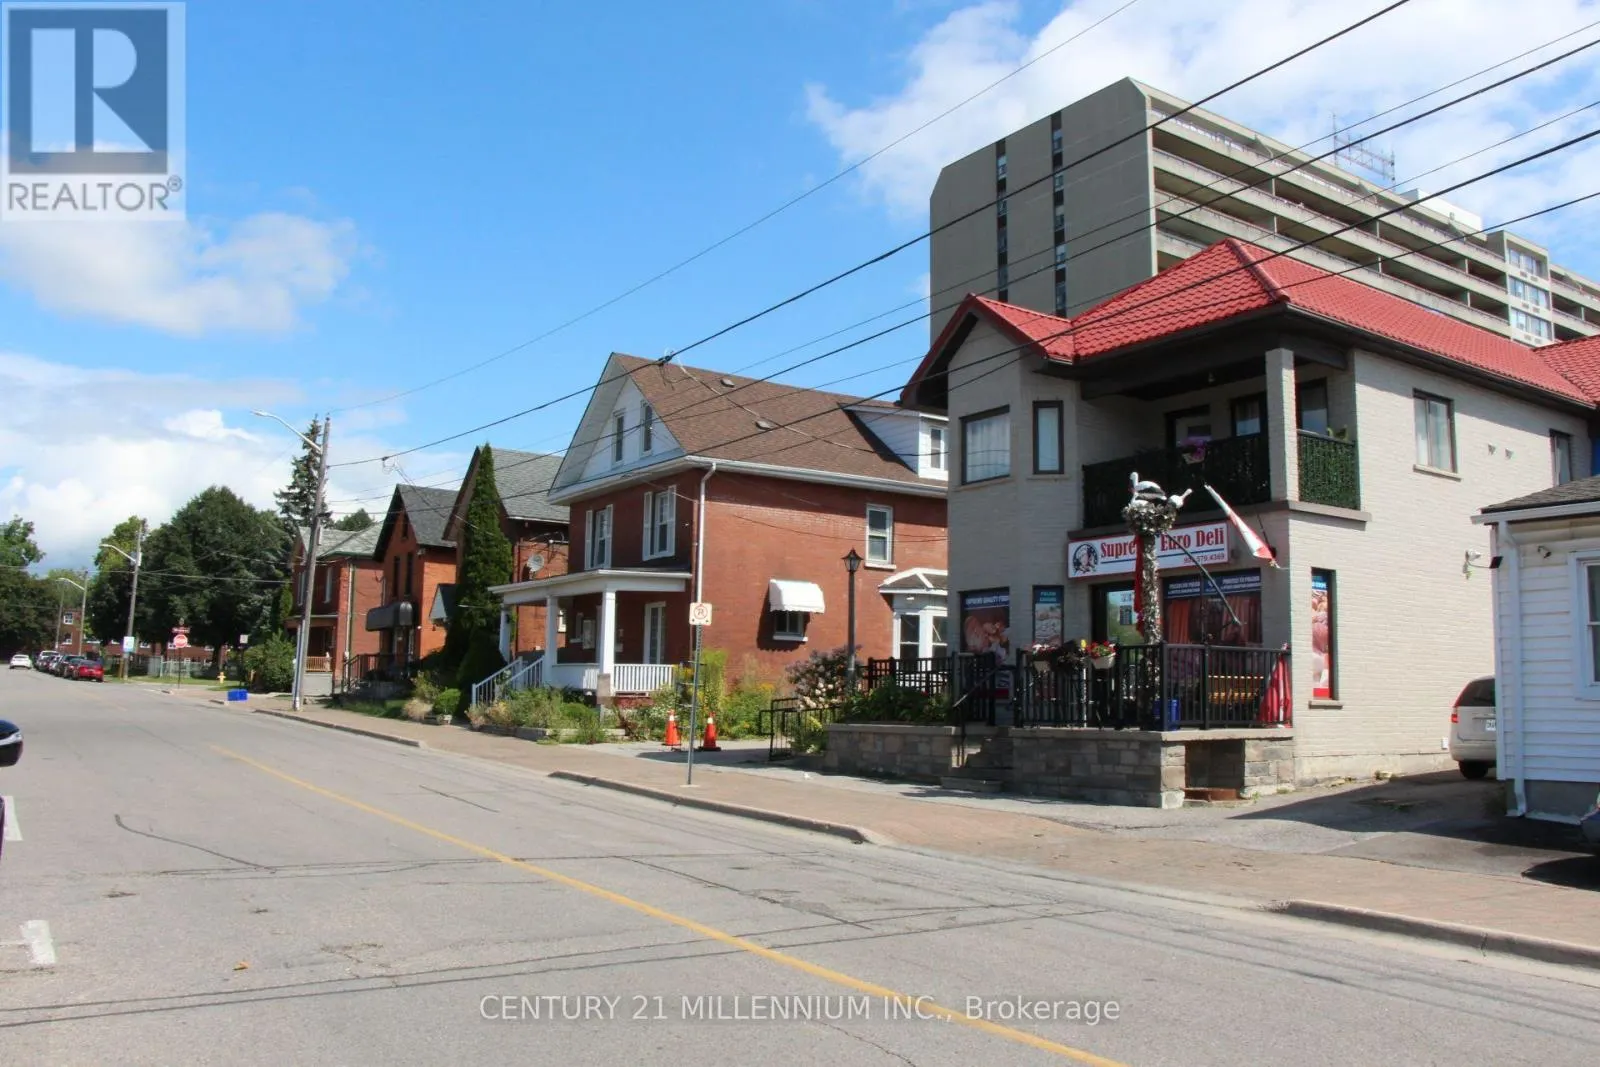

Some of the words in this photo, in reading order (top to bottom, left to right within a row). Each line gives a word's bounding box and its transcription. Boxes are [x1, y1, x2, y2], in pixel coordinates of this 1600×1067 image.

[1100, 540, 1137, 559] Supre
[1160, 533, 1191, 551] Euro
[1195, 527, 1225, 547] Deli
